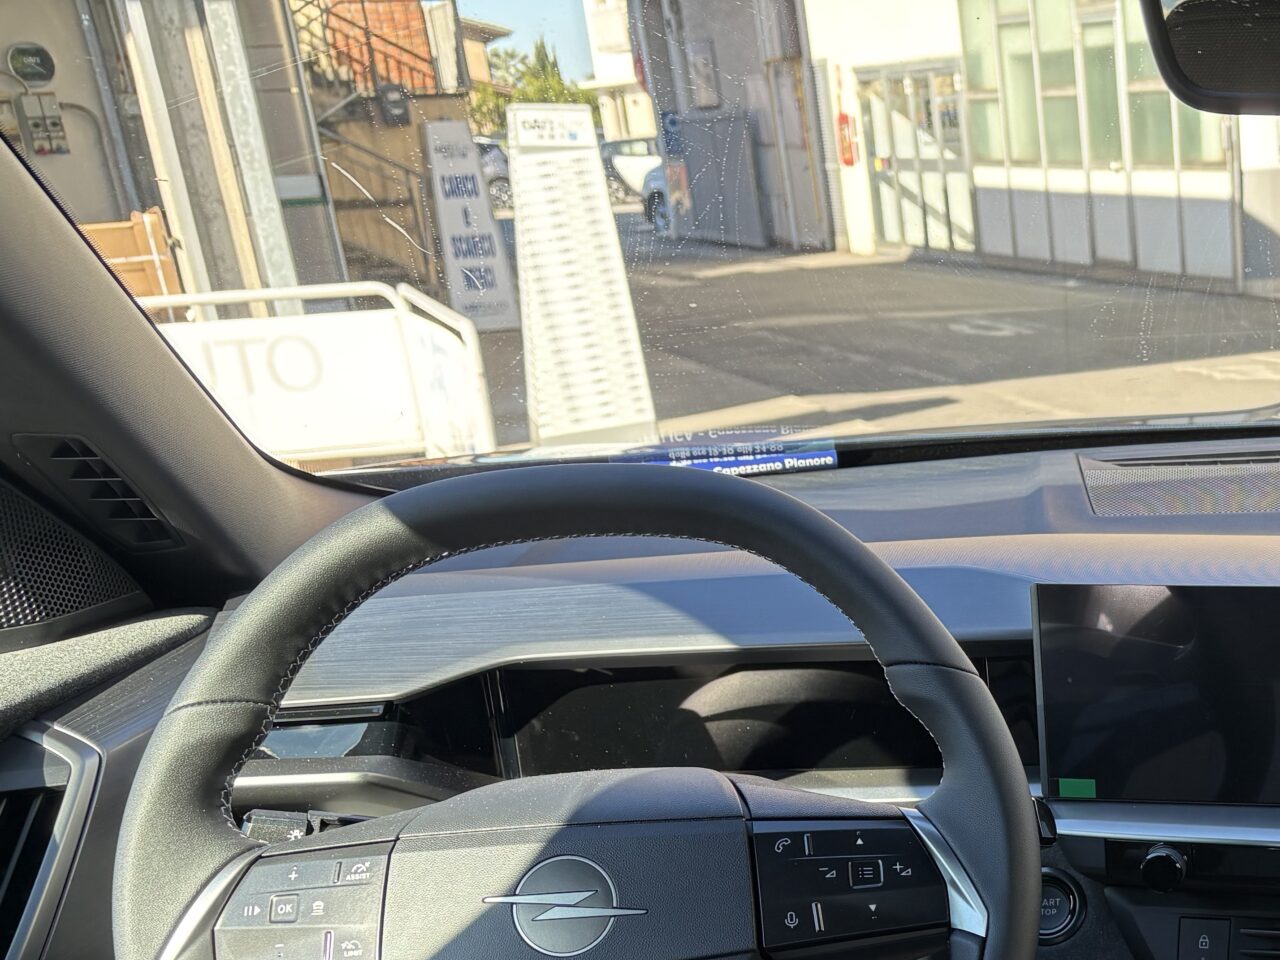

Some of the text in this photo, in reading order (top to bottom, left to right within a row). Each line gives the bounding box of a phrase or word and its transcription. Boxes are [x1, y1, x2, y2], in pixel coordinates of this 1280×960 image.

[784, 455, 834, 469] Pianore
[345, 872, 371, 881] ASSIST
[1041, 898, 1061, 907] ART
[277, 904, 293, 914] OK
[1041, 908, 1057, 916] TOP
[343, 948, 363, 958] LIMIT
